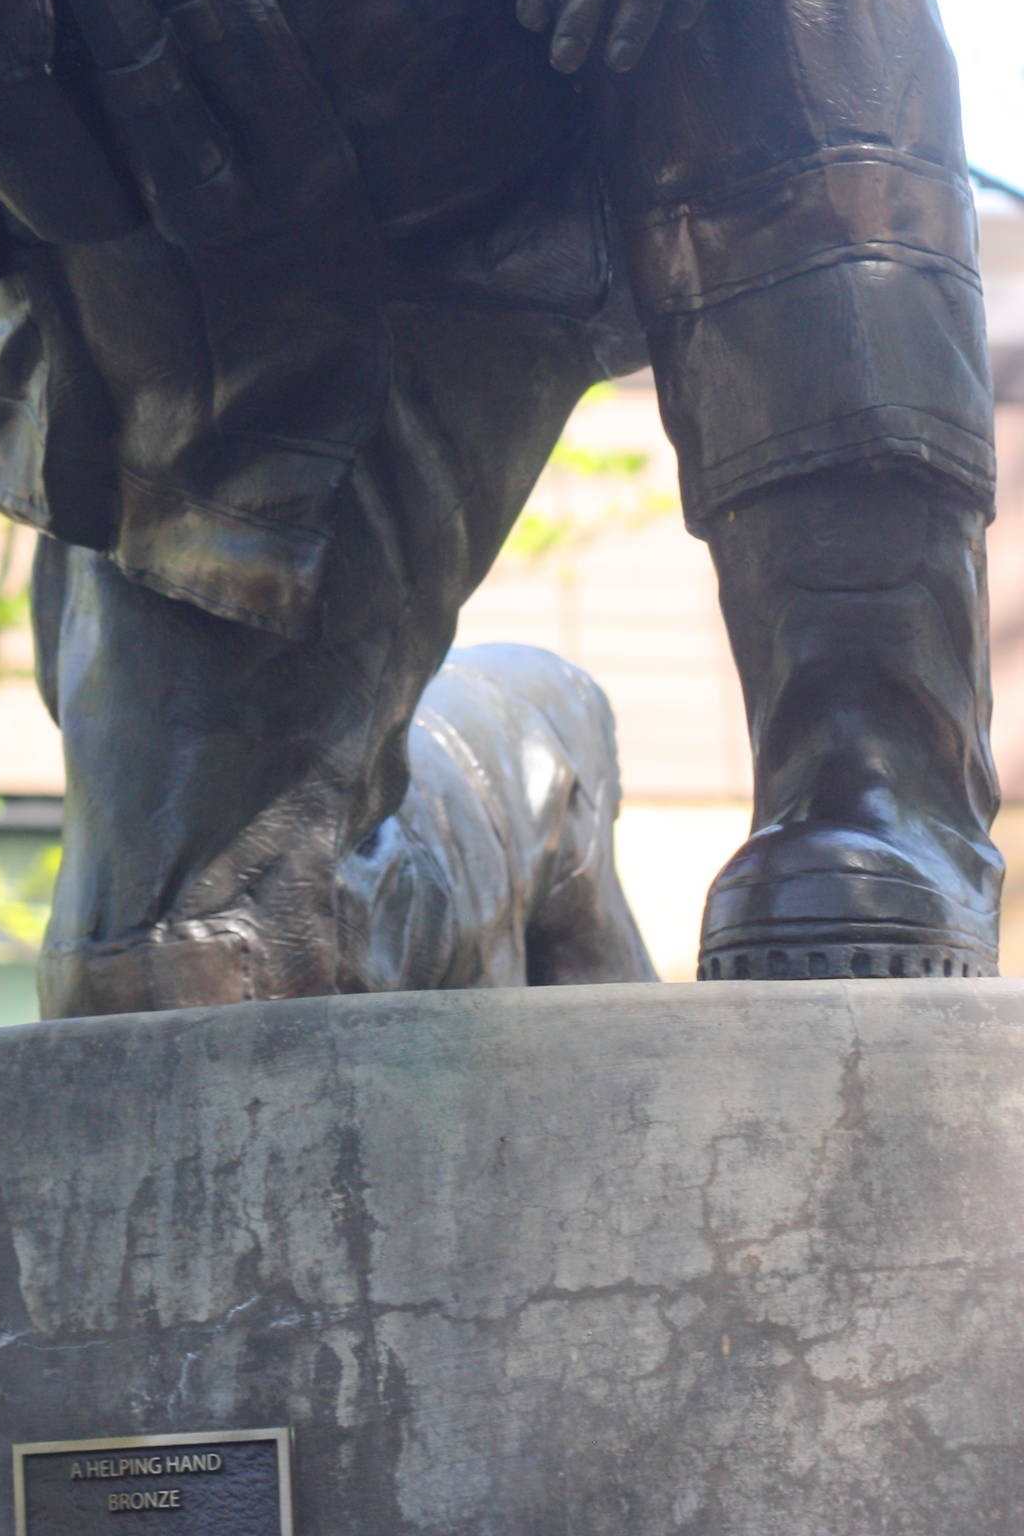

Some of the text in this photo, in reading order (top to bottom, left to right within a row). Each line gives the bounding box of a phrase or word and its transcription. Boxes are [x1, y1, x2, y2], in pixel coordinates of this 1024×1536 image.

[70, 1453, 222, 1479] A HELPING HAND
[107, 1490, 180, 1512] BRONZE
